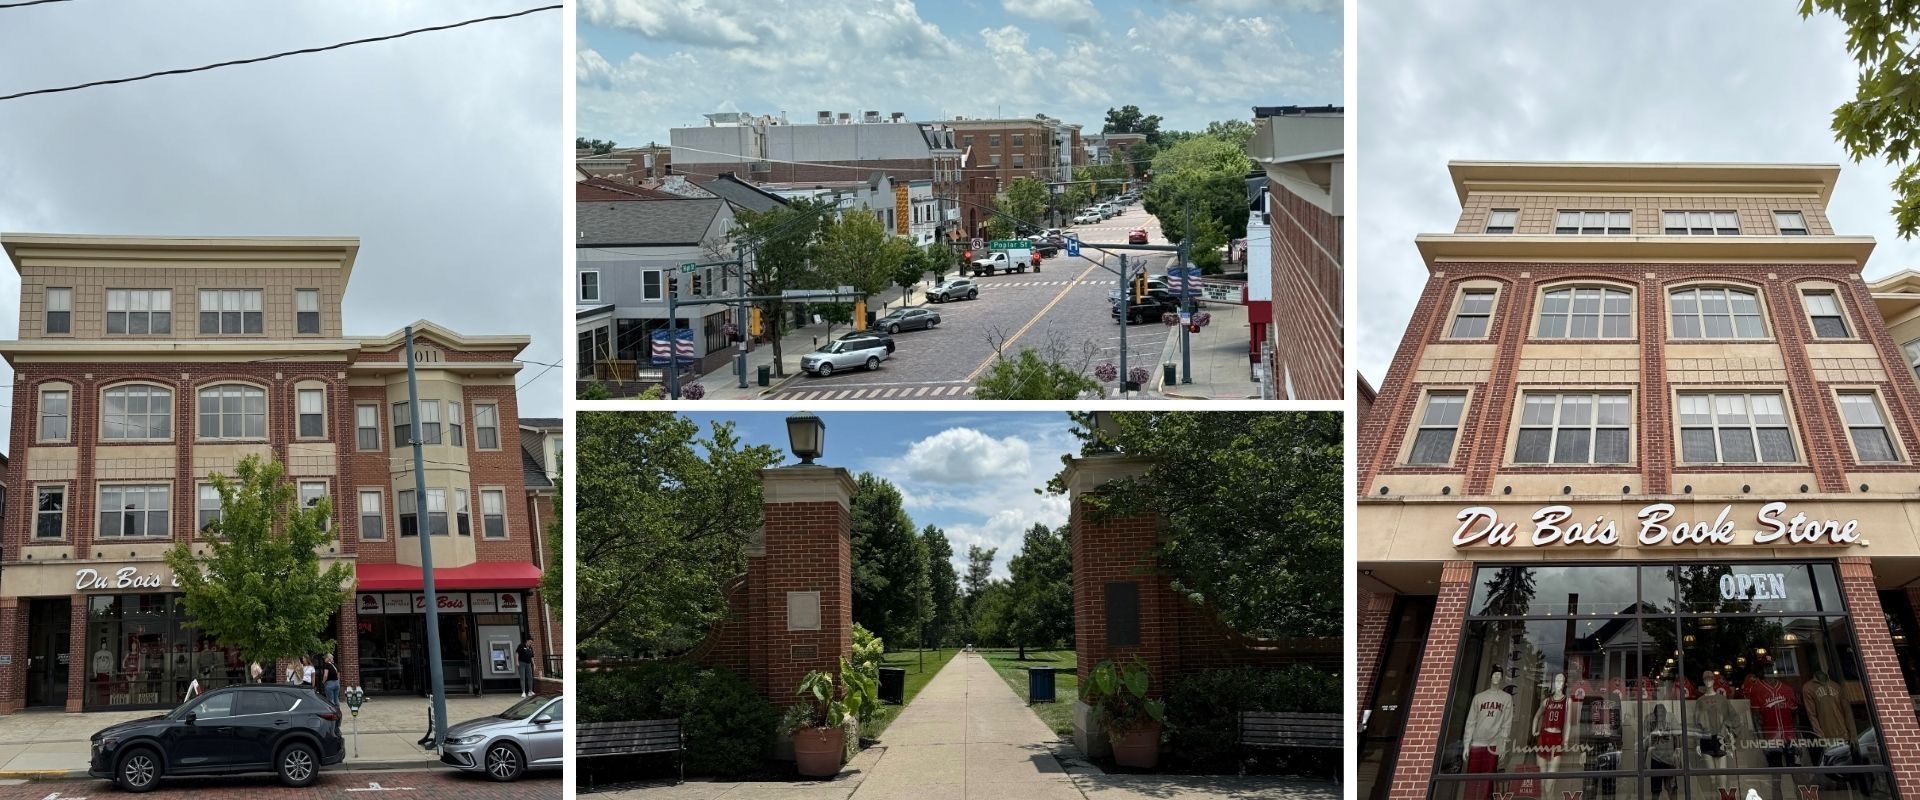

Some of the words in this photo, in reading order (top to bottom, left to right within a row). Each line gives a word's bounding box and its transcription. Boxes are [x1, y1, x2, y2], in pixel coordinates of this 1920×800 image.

[993, 241, 1017, 249] Poplar
[1069, 241, 1078, 250] H
[414, 350, 438, 362] 011
[1452, 506, 1518, 546] Du
[1531, 505, 1619, 546] Bois
[1637, 503, 1736, 545] Book
[1753, 501, 1860, 544] Store
[75, 568, 108, 589] Du
[116, 566, 161, 588] Bois
[1719, 573, 1787, 600] OPEN
[437, 595, 464, 609] Bois
[1480, 701, 1505, 712] MIAMI
[1549, 711, 1559, 722] 09
[1487, 740, 1594, 757] Champion
[1740, 739, 1785, 749] UNDER
[1789, 738, 1845, 748] ARMOUR
